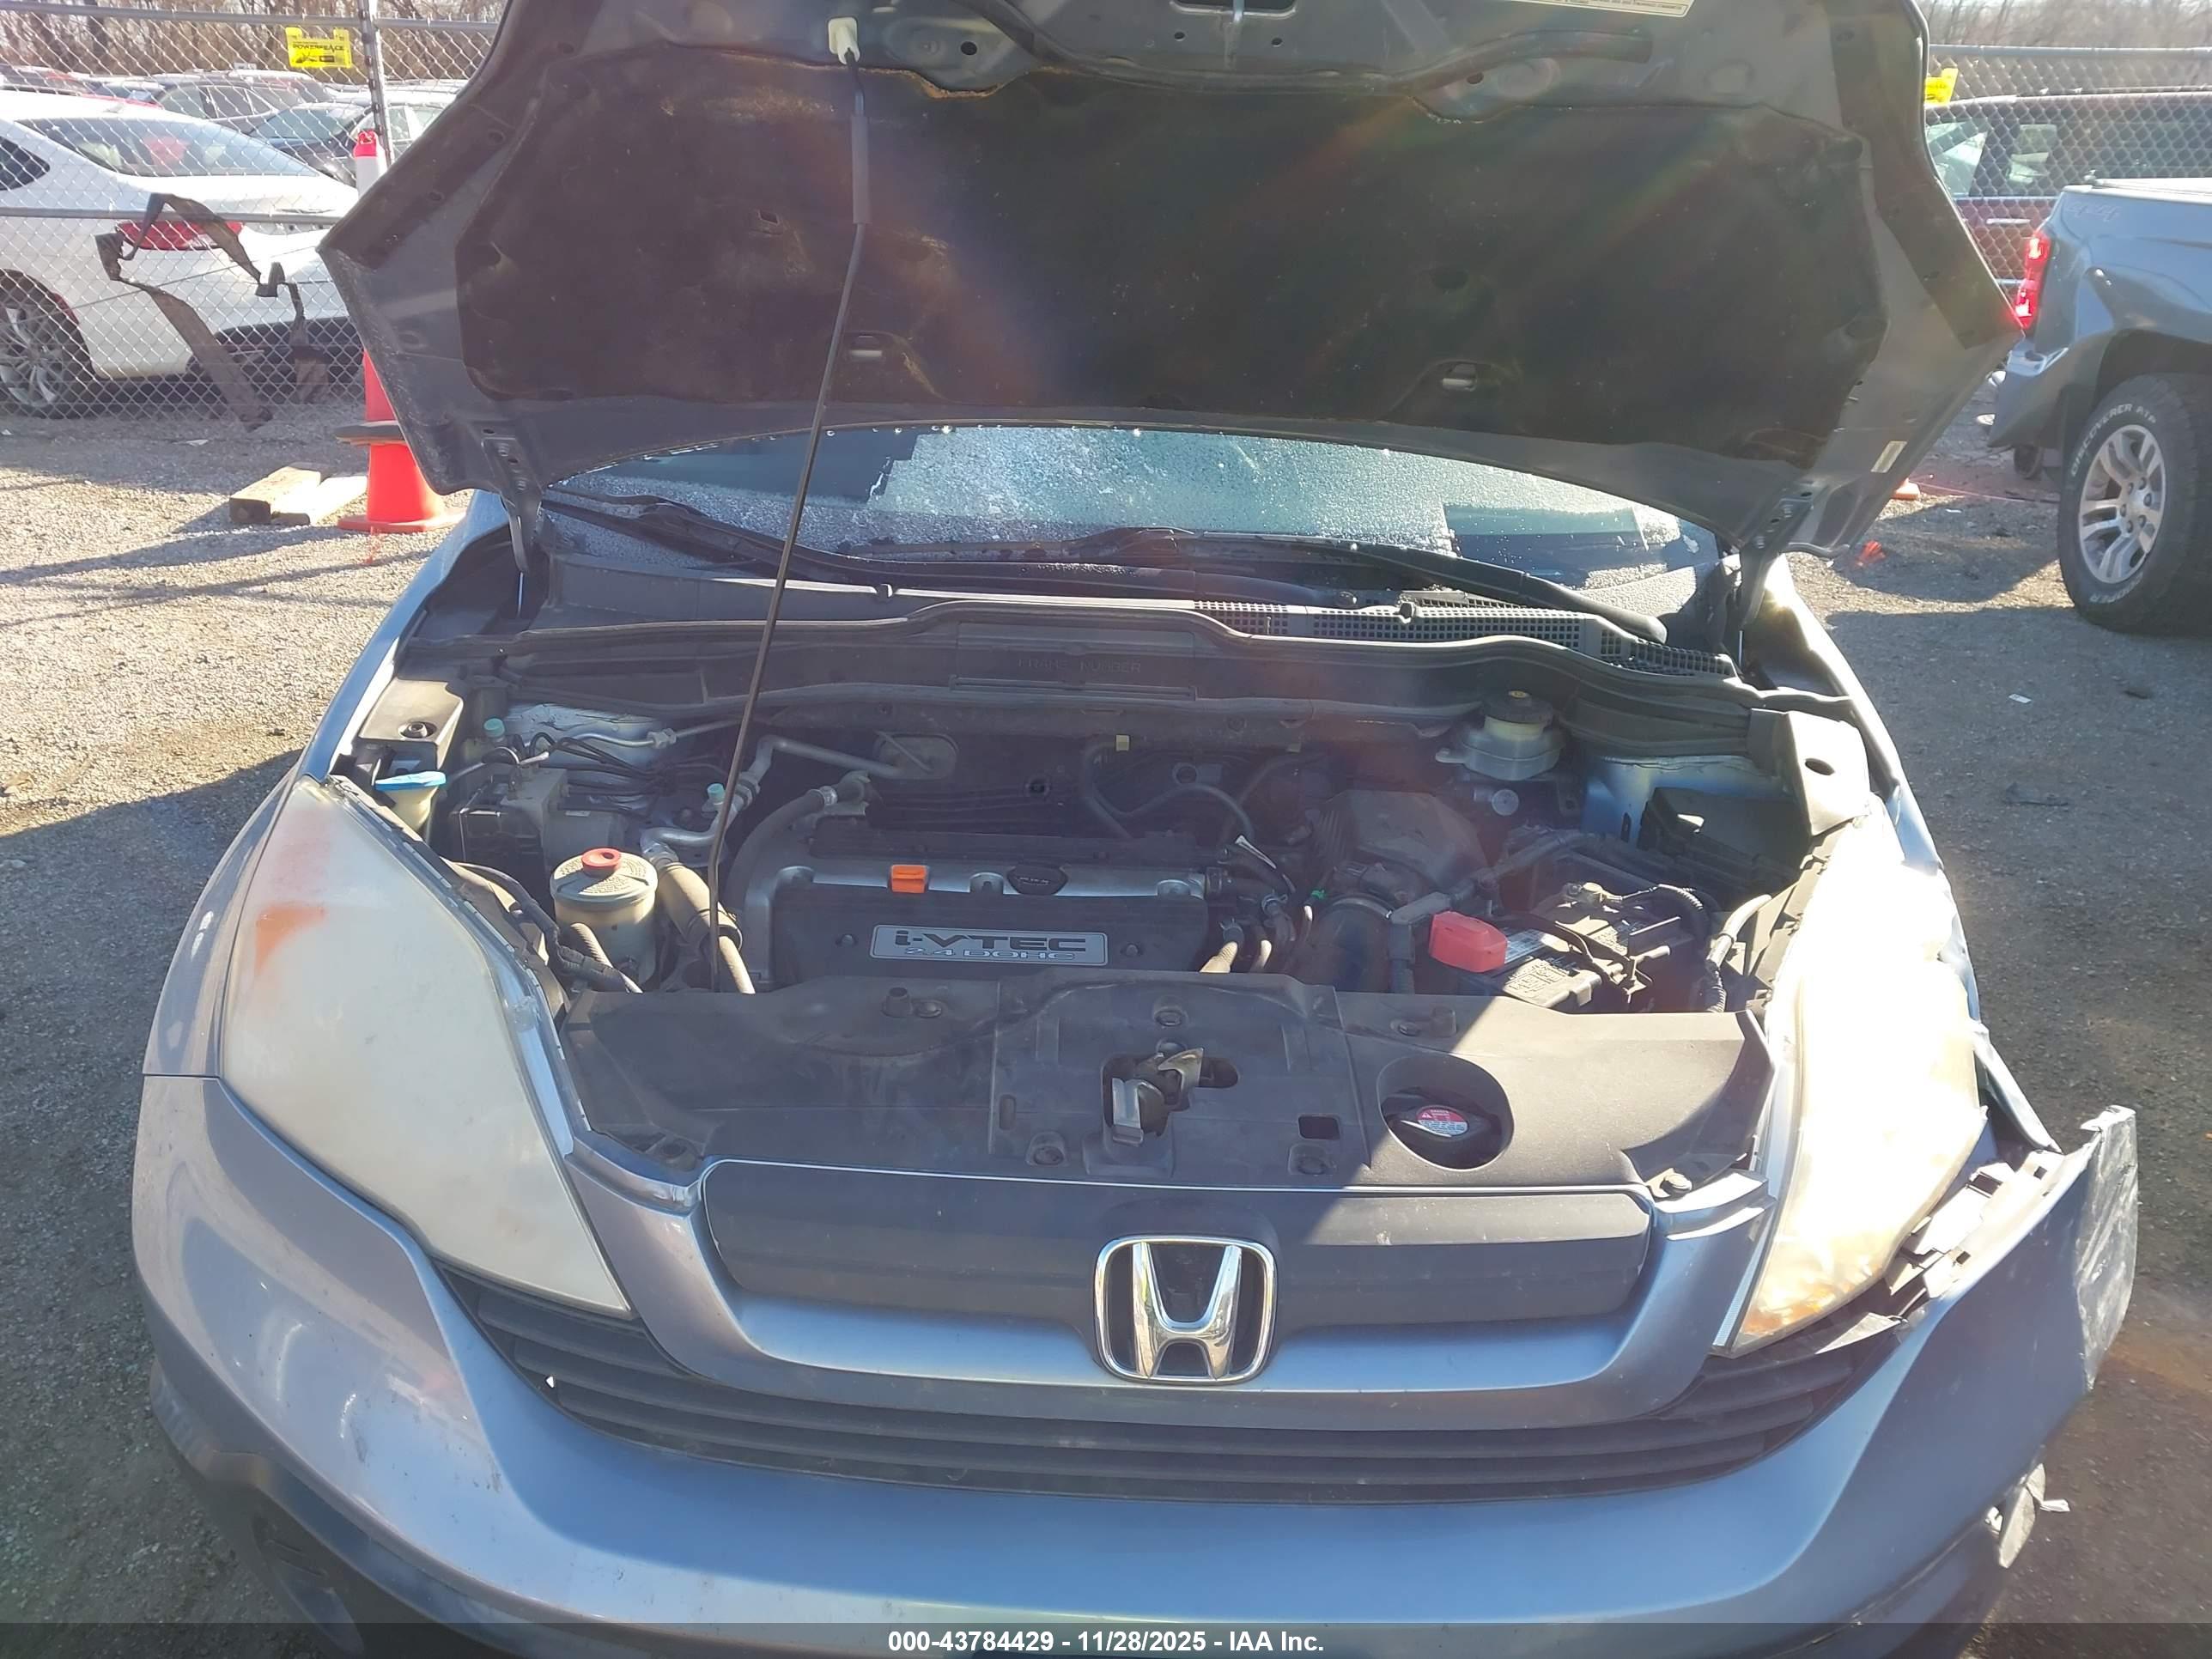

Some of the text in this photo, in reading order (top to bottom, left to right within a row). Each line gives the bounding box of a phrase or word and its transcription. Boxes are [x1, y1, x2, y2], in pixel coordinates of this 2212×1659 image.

[2069, 403, 2133, 477] DISCOVERER
[1079, 659, 1142, 674] NUMBER
[895, 930, 1086, 952] i-VTEC
[905, 946, 1076, 961] 2.4 DOHC
